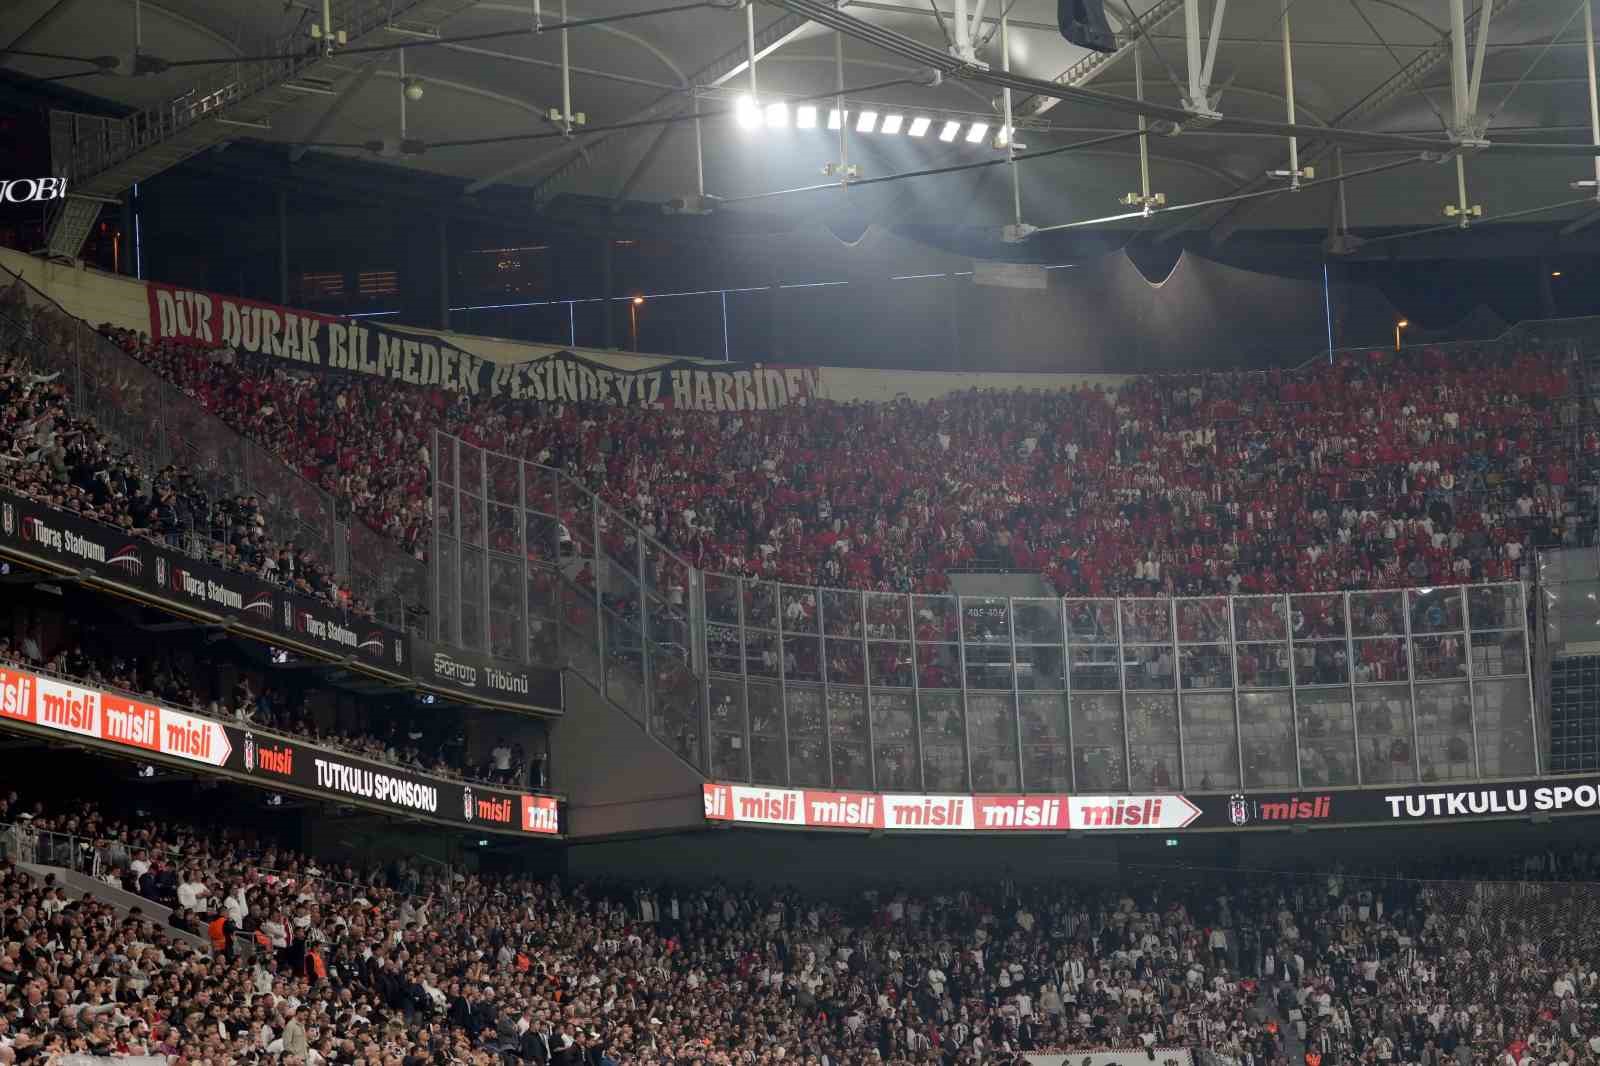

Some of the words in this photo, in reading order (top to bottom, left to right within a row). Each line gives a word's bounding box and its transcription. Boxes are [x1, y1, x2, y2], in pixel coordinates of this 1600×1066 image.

[0, 177, 68, 203] OB
[156, 289, 214, 343] DUR
[222, 300, 321, 365] DURAK
[64, 530, 105, 563] Stadyumu
[484, 667, 529, 694] Tribünü
[43, 691, 95, 731] misli
[106, 705, 155, 744] misli
[167, 720, 212, 758] misli
[259, 745, 292, 775] misli
[314, 758, 373, 797] TUTKULU
[374, 775, 437, 812] SPONSORU
[478, 799, 511, 823] misli
[739, 791, 797, 820] misli
[811, 796, 876, 825] misli
[892, 799, 965, 826] misli
[982, 800, 1060, 827] misli
[1080, 799, 1162, 826] misli
[1260, 796, 1331, 819] misli
[1385, 789, 1528, 818] TUTKULU
[1534, 784, 1600, 810] SPO
